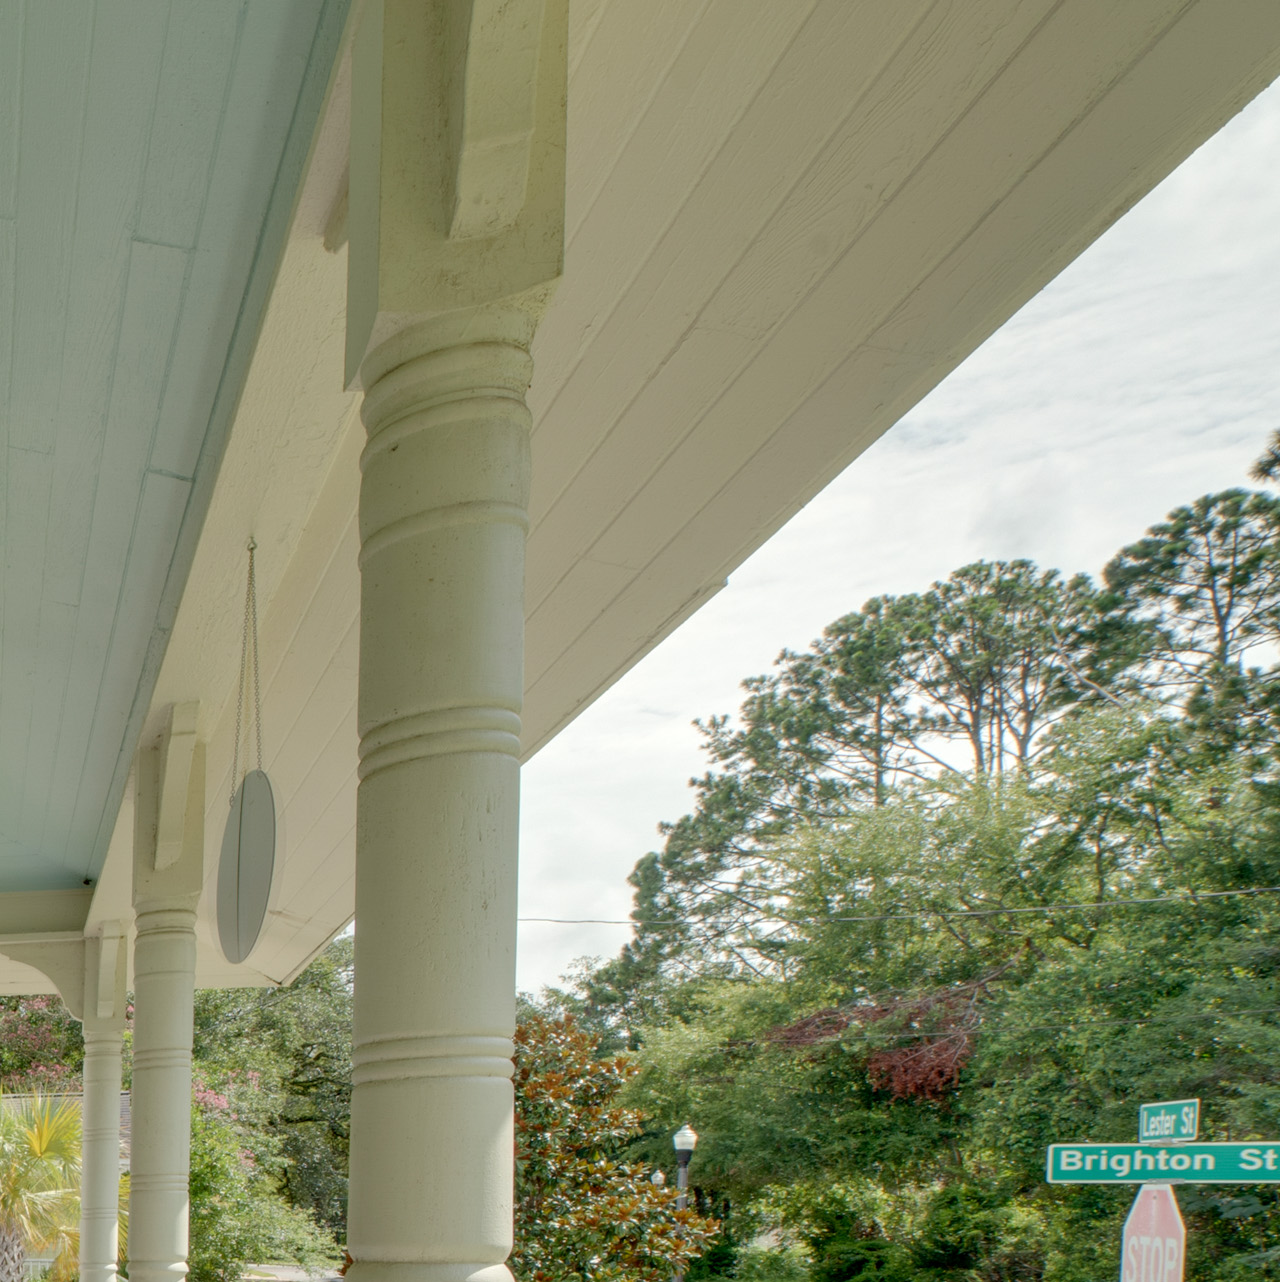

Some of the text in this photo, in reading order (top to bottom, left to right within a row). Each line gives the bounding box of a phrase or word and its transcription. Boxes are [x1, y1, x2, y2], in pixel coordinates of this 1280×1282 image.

[1142, 1106, 1194, 1137] Lester St
[1059, 1148, 1278, 1177] Brighton St
